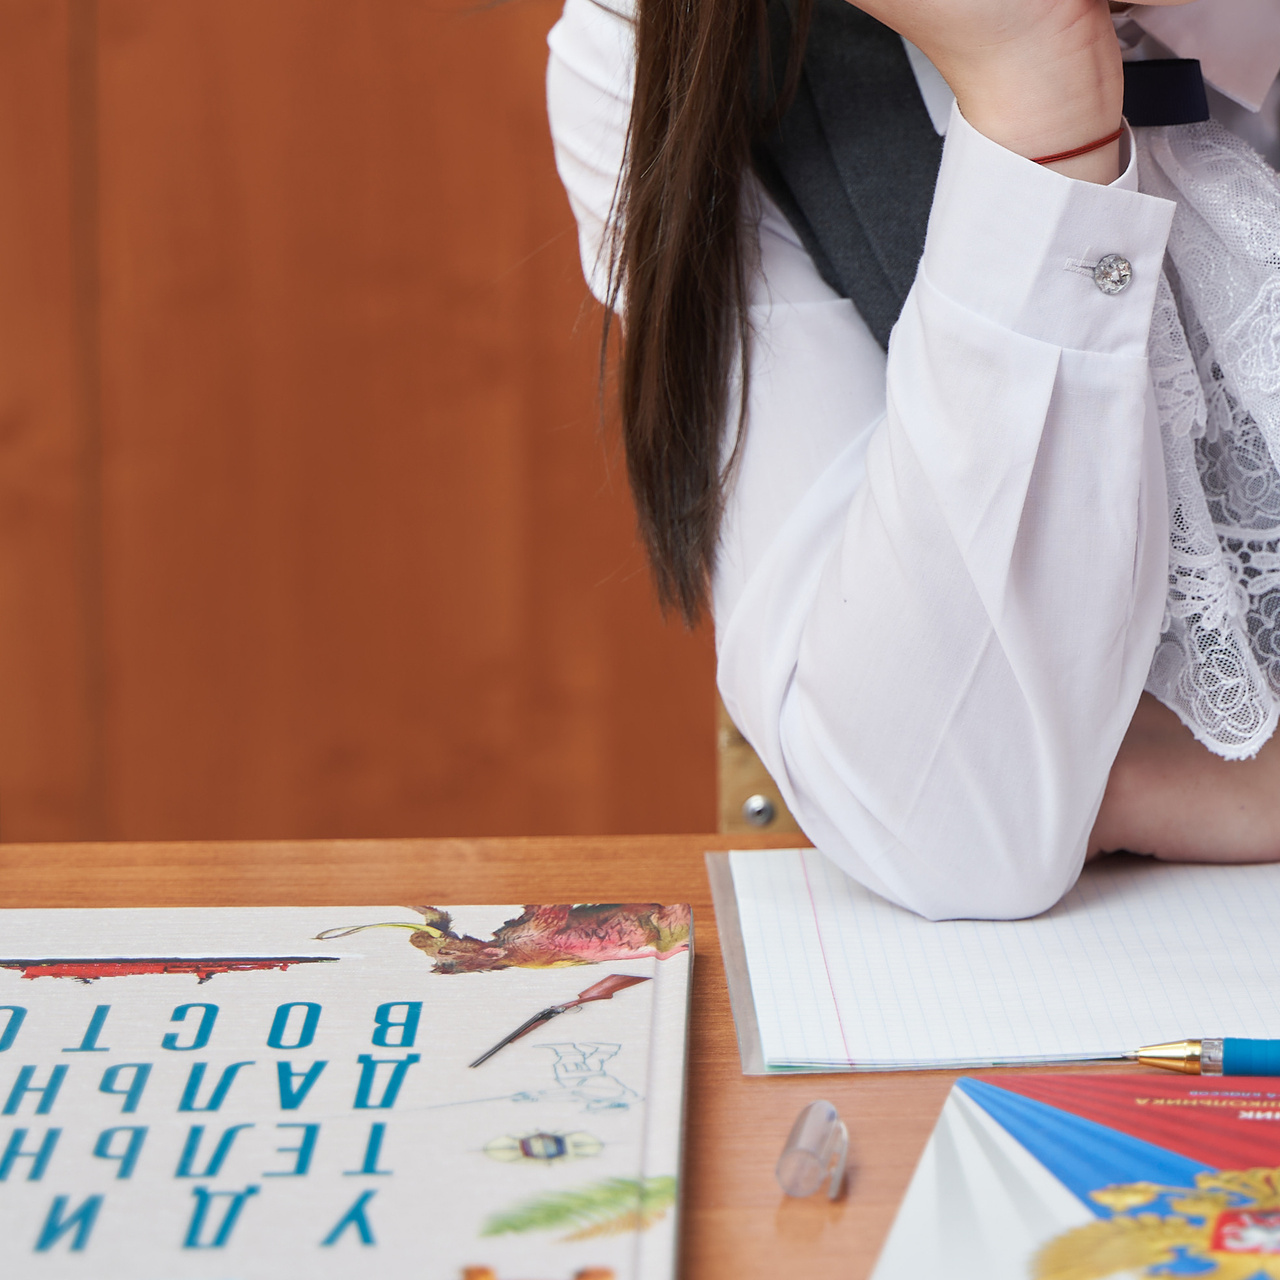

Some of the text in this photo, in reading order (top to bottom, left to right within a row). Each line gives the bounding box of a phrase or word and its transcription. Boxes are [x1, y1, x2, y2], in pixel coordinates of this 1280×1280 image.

[1, 1053, 421, 1115] ДАЛЬН
[0, 1122, 393, 1182] ТЕЛЬН
[34, 1185, 378, 1253] УДИ
